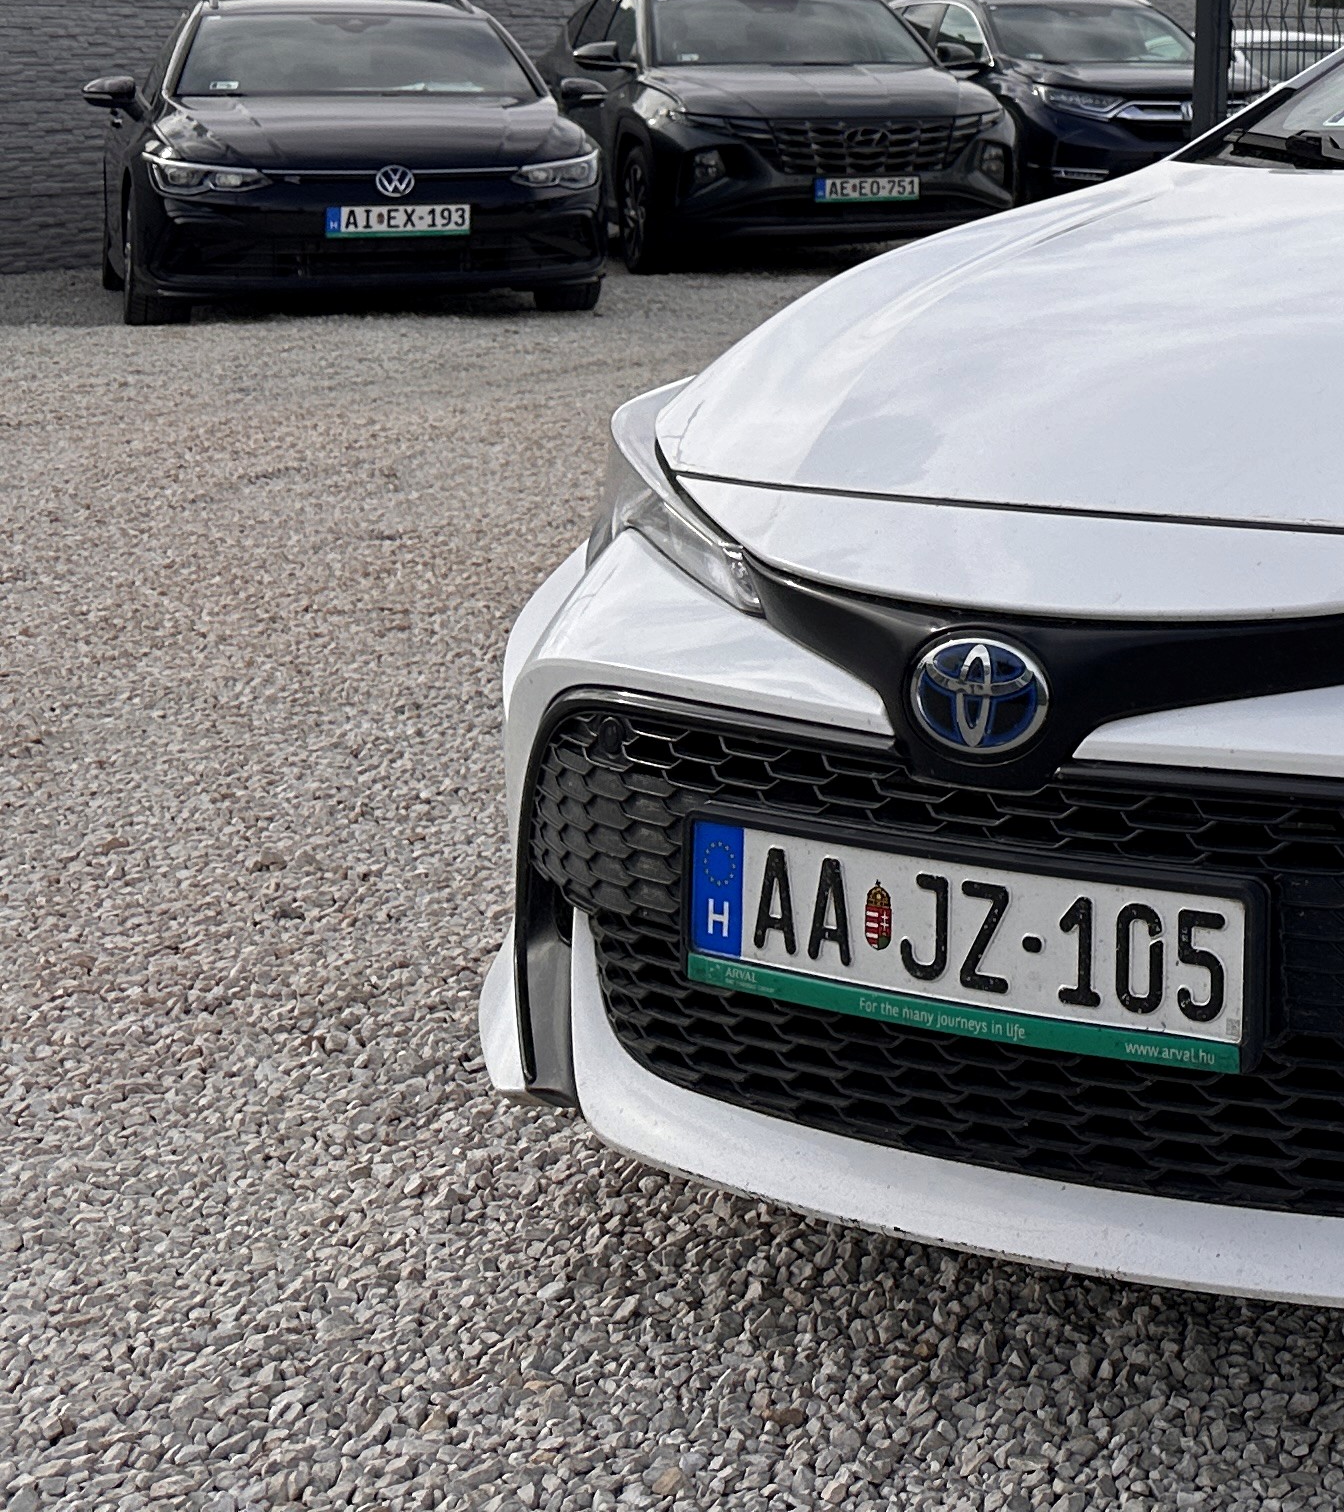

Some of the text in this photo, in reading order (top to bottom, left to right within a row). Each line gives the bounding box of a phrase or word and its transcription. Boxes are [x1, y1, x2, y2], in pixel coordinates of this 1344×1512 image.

[707, 897, 730, 938] H
[725, 967, 758, 984] ARVAL
[859, 997, 1026, 1041] For the many journeys in life
[1124, 1042, 1216, 1065] www.arval.hu
